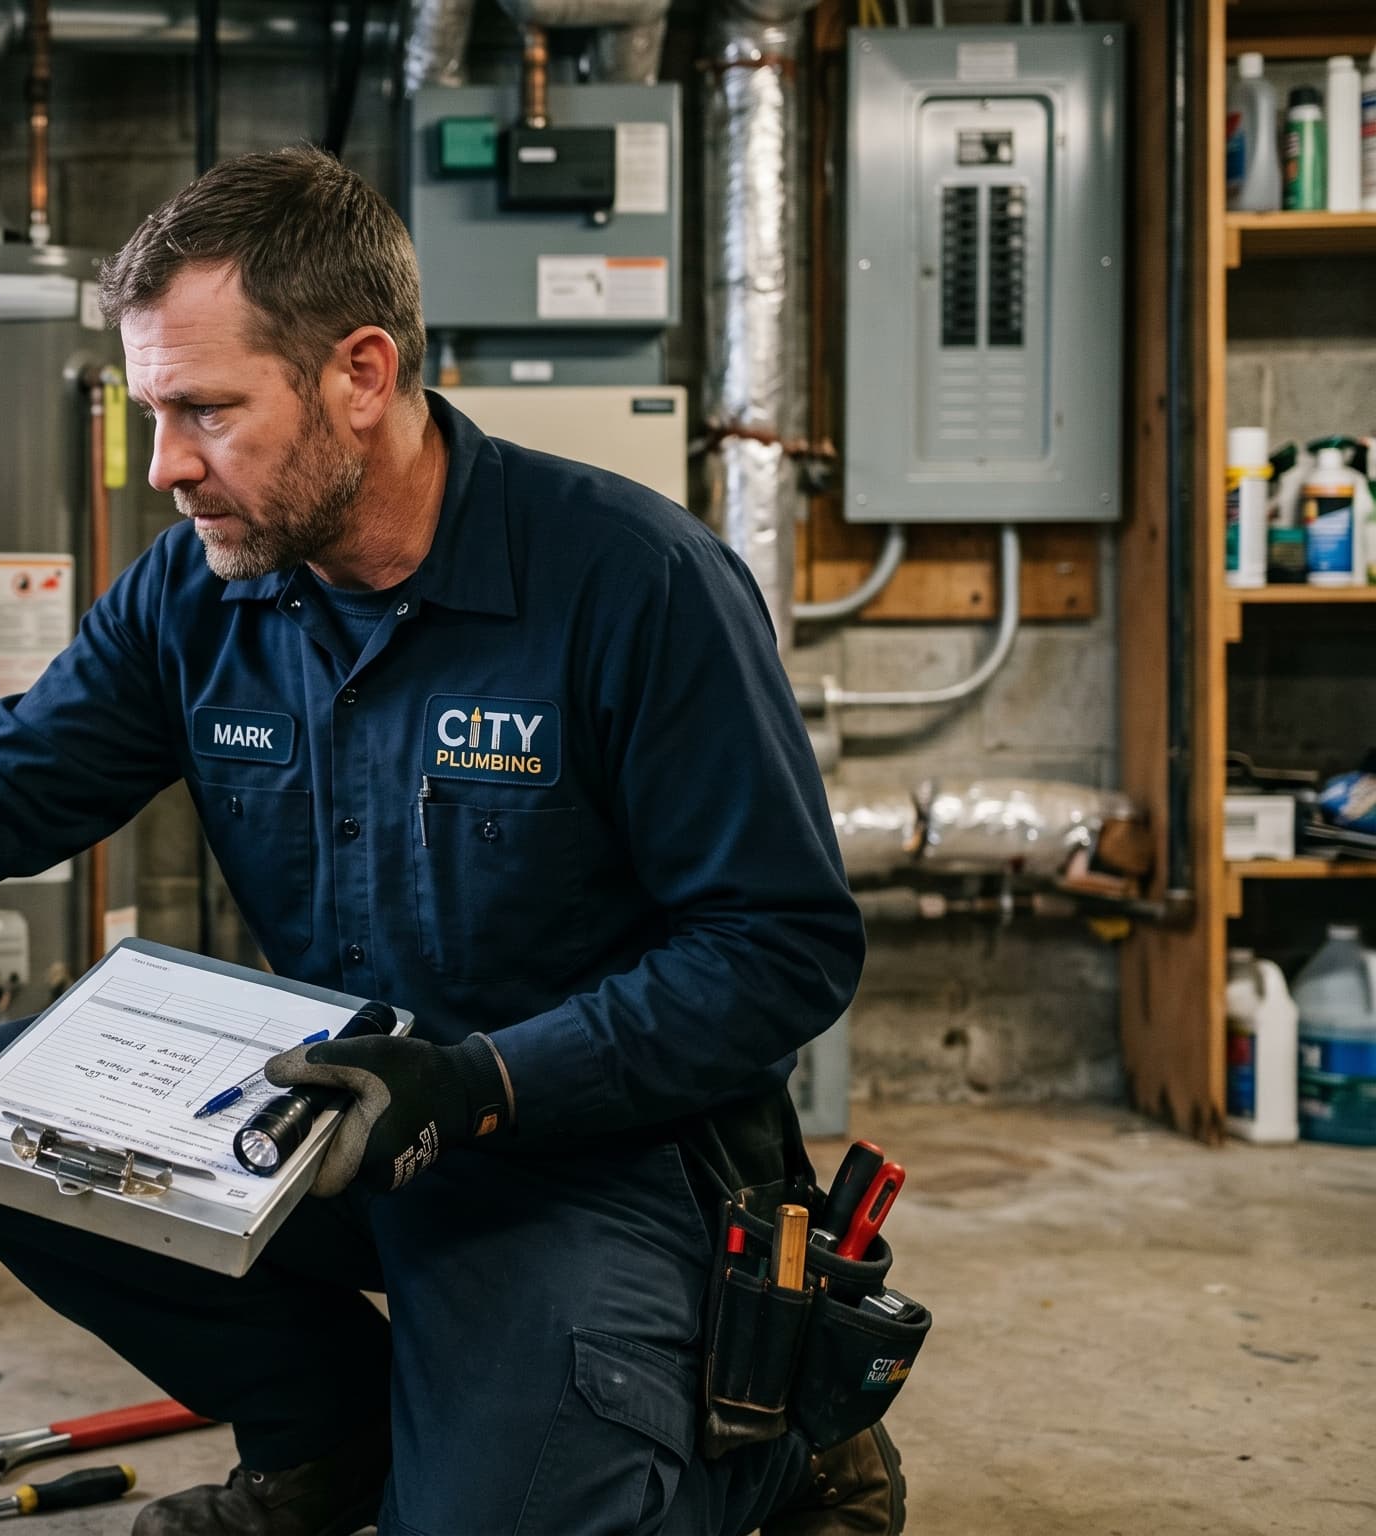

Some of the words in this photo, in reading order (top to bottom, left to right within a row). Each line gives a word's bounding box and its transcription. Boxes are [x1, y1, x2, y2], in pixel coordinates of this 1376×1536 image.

[212, 722, 274, 750] MARK
[436, 705, 544, 753] CITY
[436, 749, 543, 775] PLUMBING
